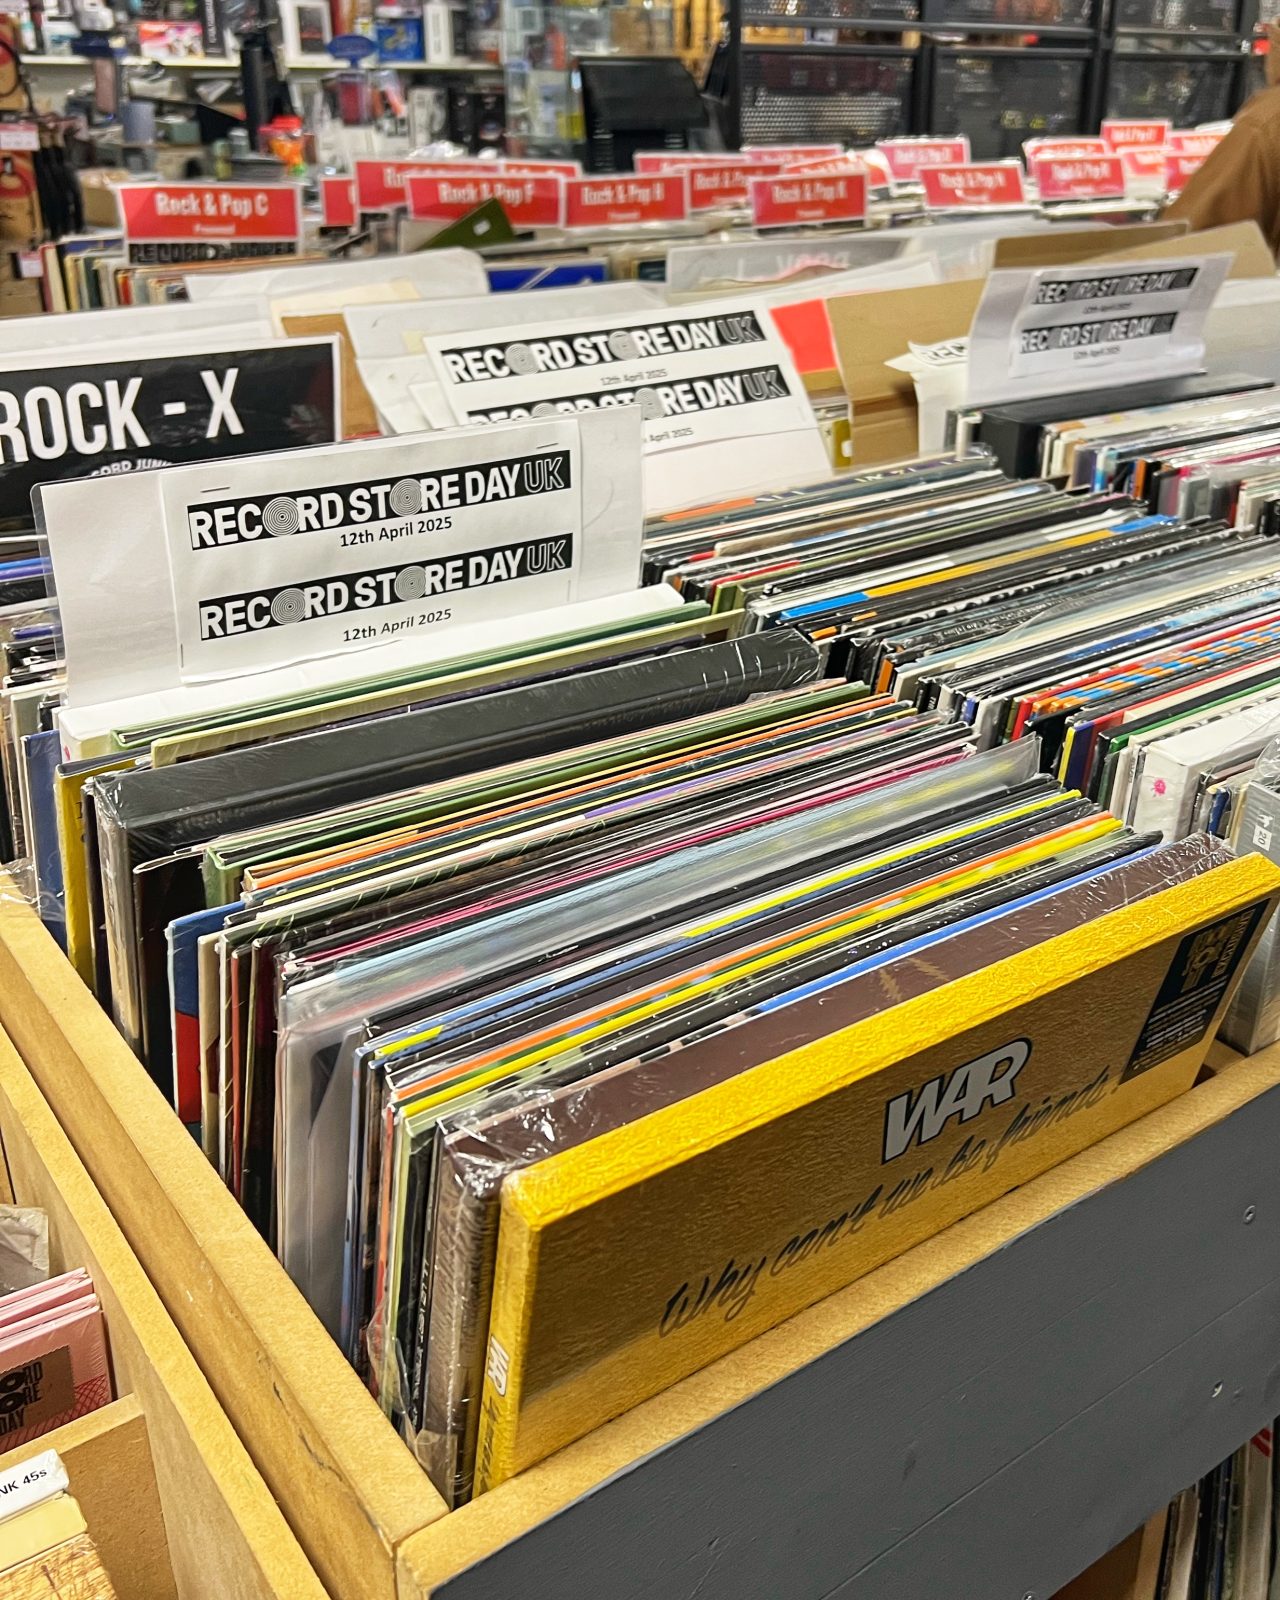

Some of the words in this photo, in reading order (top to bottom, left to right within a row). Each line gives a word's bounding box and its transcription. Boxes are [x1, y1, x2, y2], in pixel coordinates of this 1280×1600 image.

[155, 191, 200, 216] Rock
[203, 191, 217, 216] &
[219, 191, 252, 220] Pop
[254, 191, 269, 216] C
[438, 182, 477, 204] Rock
[494, 182, 522, 207] Pop
[443, 339, 575, 383] RECORD
[575, 328, 667, 367] STORE
[667, 320, 719, 353] DAY
[717, 315, 761, 345] UK
[601, 374, 620, 386] 12th
[622, 372, 644, 386] April
[646, 369, 668, 380] 2025
[699, 374, 749, 411] DAY
[743, 370, 787, 399] UK
[0, 376, 151, 465] ROCK
[200, 367, 244, 439] X
[650, 430, 671, 444] April
[673, 427, 694, 438] 2025
[189, 493, 344, 549] RECORD
[349, 473, 460, 522] STORE
[465, 464, 522, 505] DAY
[523, 456, 565, 494] UK
[340, 527, 375, 548] 12th
[378, 523, 413, 543] April
[417, 516, 453, 534] 2025
[200, 582, 349, 639] RECORD
[354, 560, 463, 609] STORE
[468, 547, 525, 587] DAY
[526, 539, 567, 574] UK
[342, 625, 376, 642] 12th
[380, 617, 414, 637] April
[418, 608, 452, 627] 2025
[881, 1037, 1032, 1164] WAR
[660, 1254, 767, 1338] Why
[770, 1184, 884, 1277] can't
[878, 1167, 934, 1219] we
[934, 1135, 987, 1187] be
[487, 1334, 510, 1397] WAR
[23, 1468, 48, 1486] 45s
